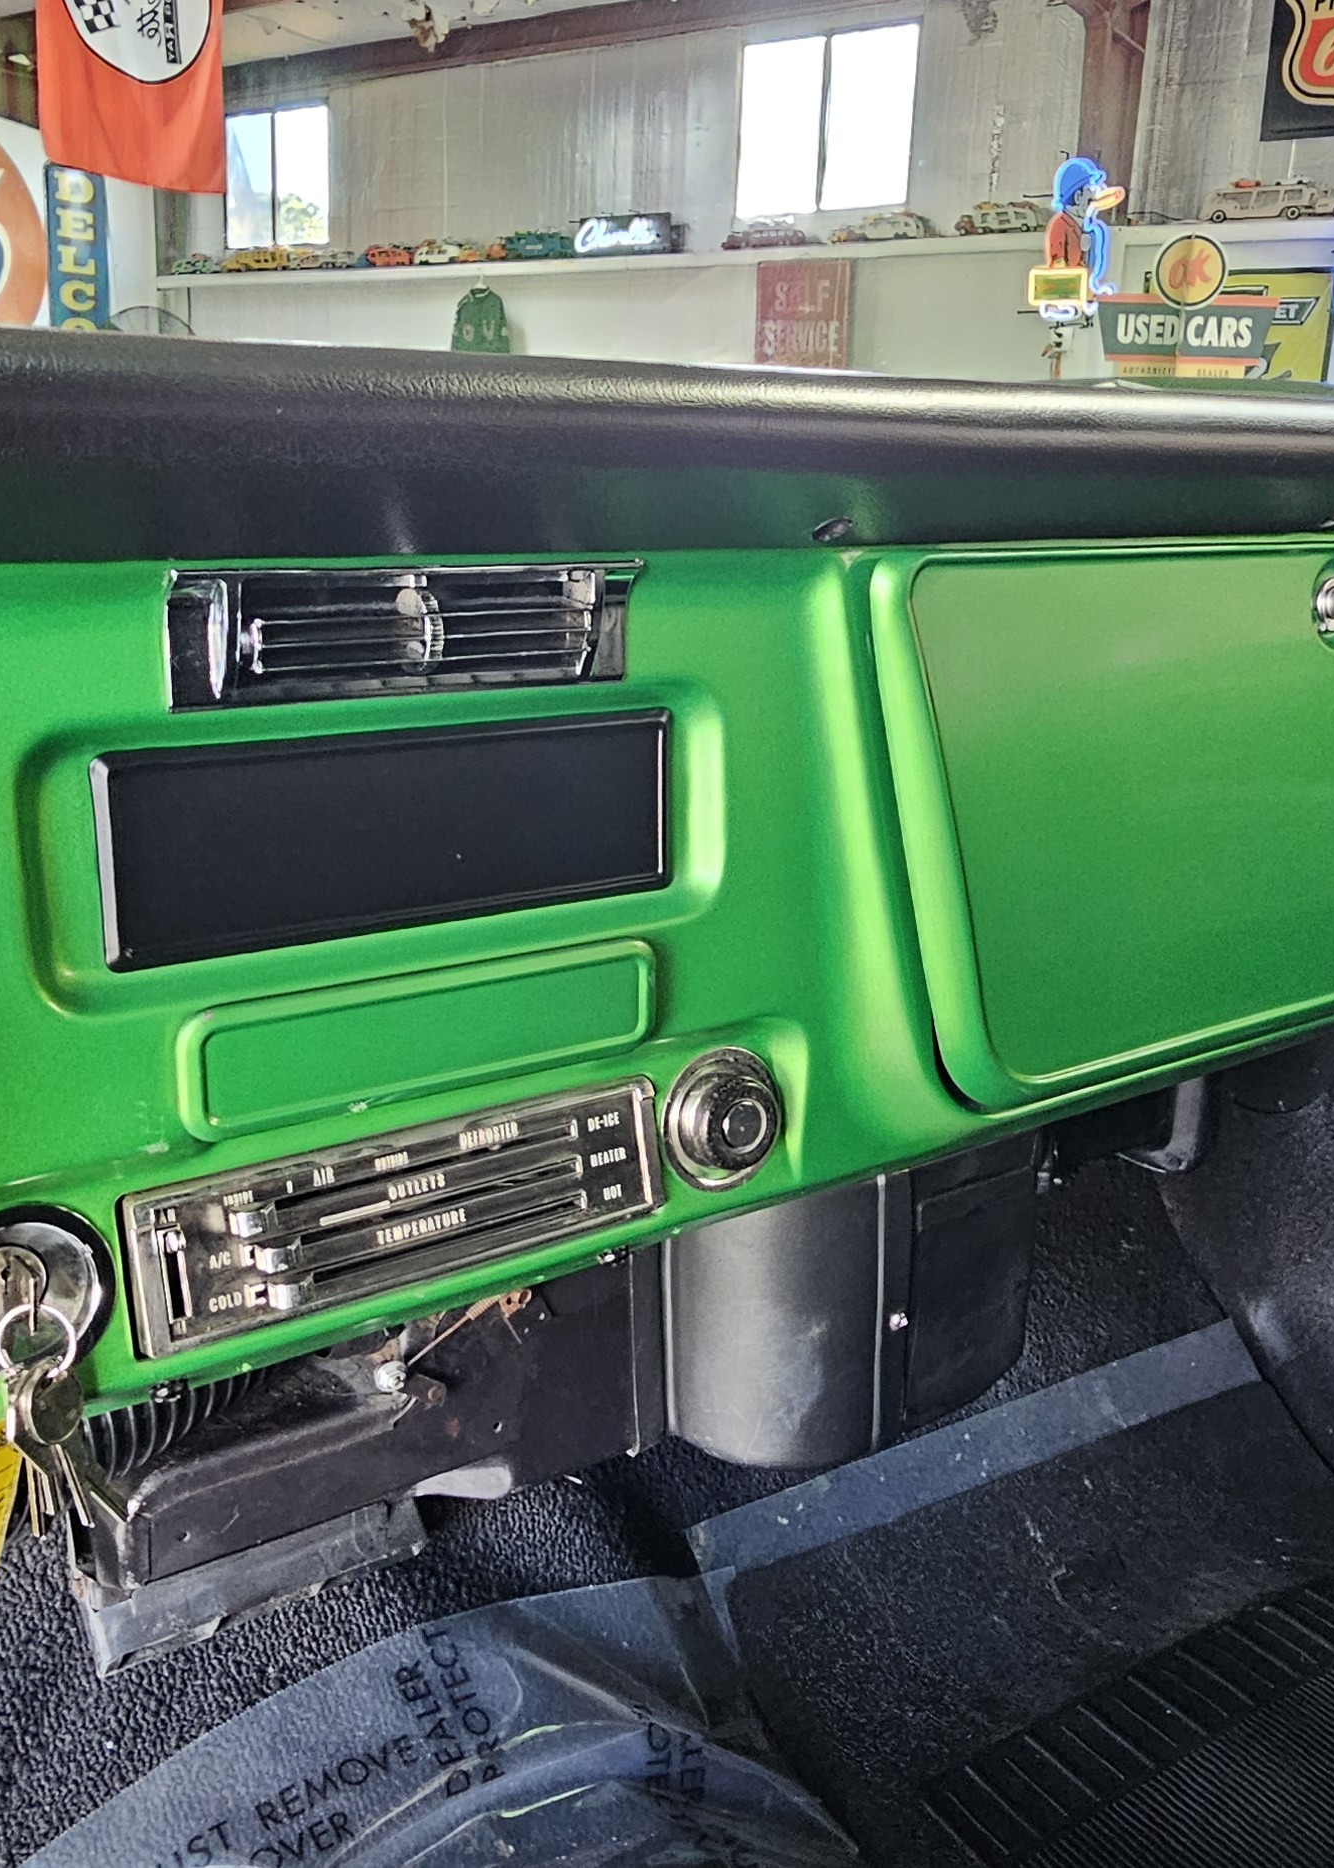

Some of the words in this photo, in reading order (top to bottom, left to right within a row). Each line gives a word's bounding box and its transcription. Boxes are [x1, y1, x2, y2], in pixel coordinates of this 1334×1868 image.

[1168, 247, 1212, 290] OK
[762, 320, 840, 356] SERVICE
[1117, 313, 1181, 345] USED
[1185, 315, 1253, 348] CARS
[587, 1111, 621, 1133] DE-ICE
[590, 1146, 627, 1168] HEATER
[312, 1165, 336, 1188] AIR
[388, 1173, 446, 1201] OUTLETS
[376, 1207, 467, 1246] TEMPERATURE
[209, 1250, 232, 1270] A/C
[208, 1290, 243, 1313] COLD
[396, 1659, 471, 1799] DEALER
[254, 1733, 419, 1831] REMOVE
